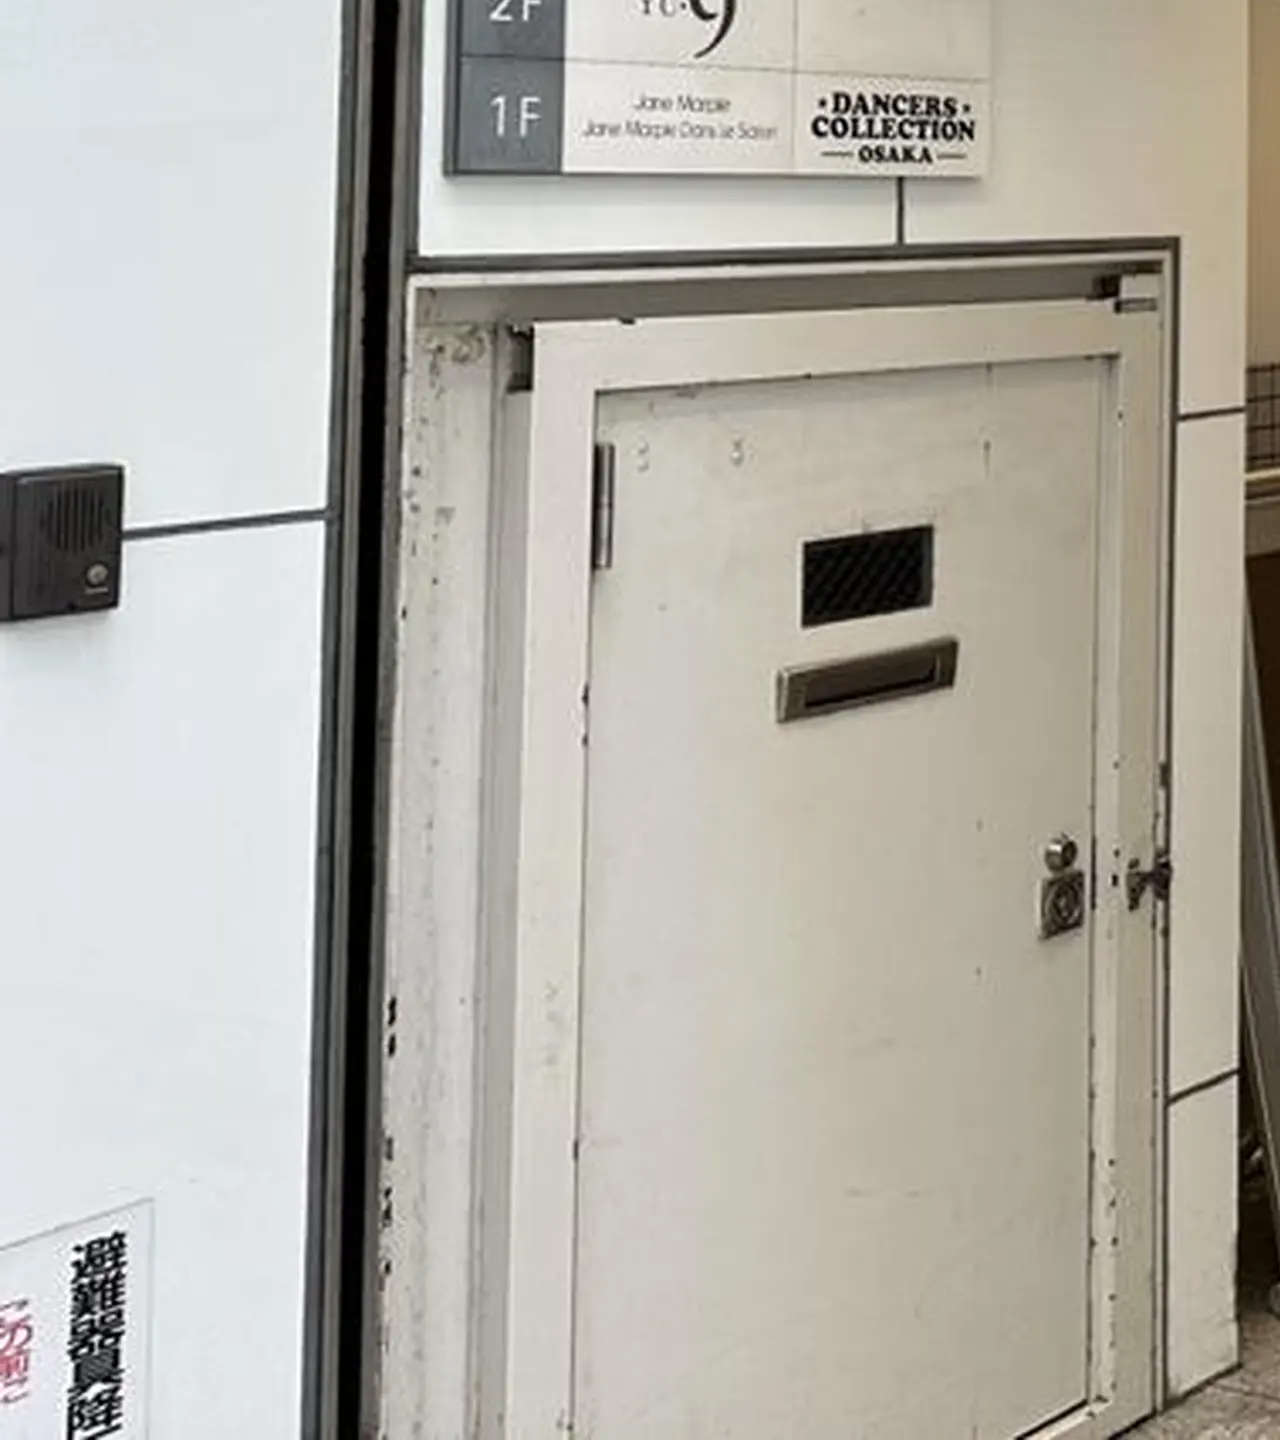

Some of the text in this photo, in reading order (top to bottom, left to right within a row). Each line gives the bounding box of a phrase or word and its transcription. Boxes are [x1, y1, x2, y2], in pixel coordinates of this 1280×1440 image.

[491, 93, 543, 138] 1F
[831, 90, 960, 118] DANCERS
[810, 114, 977, 143] COLLECTION
[857, 144, 934, 165] OSAKA
